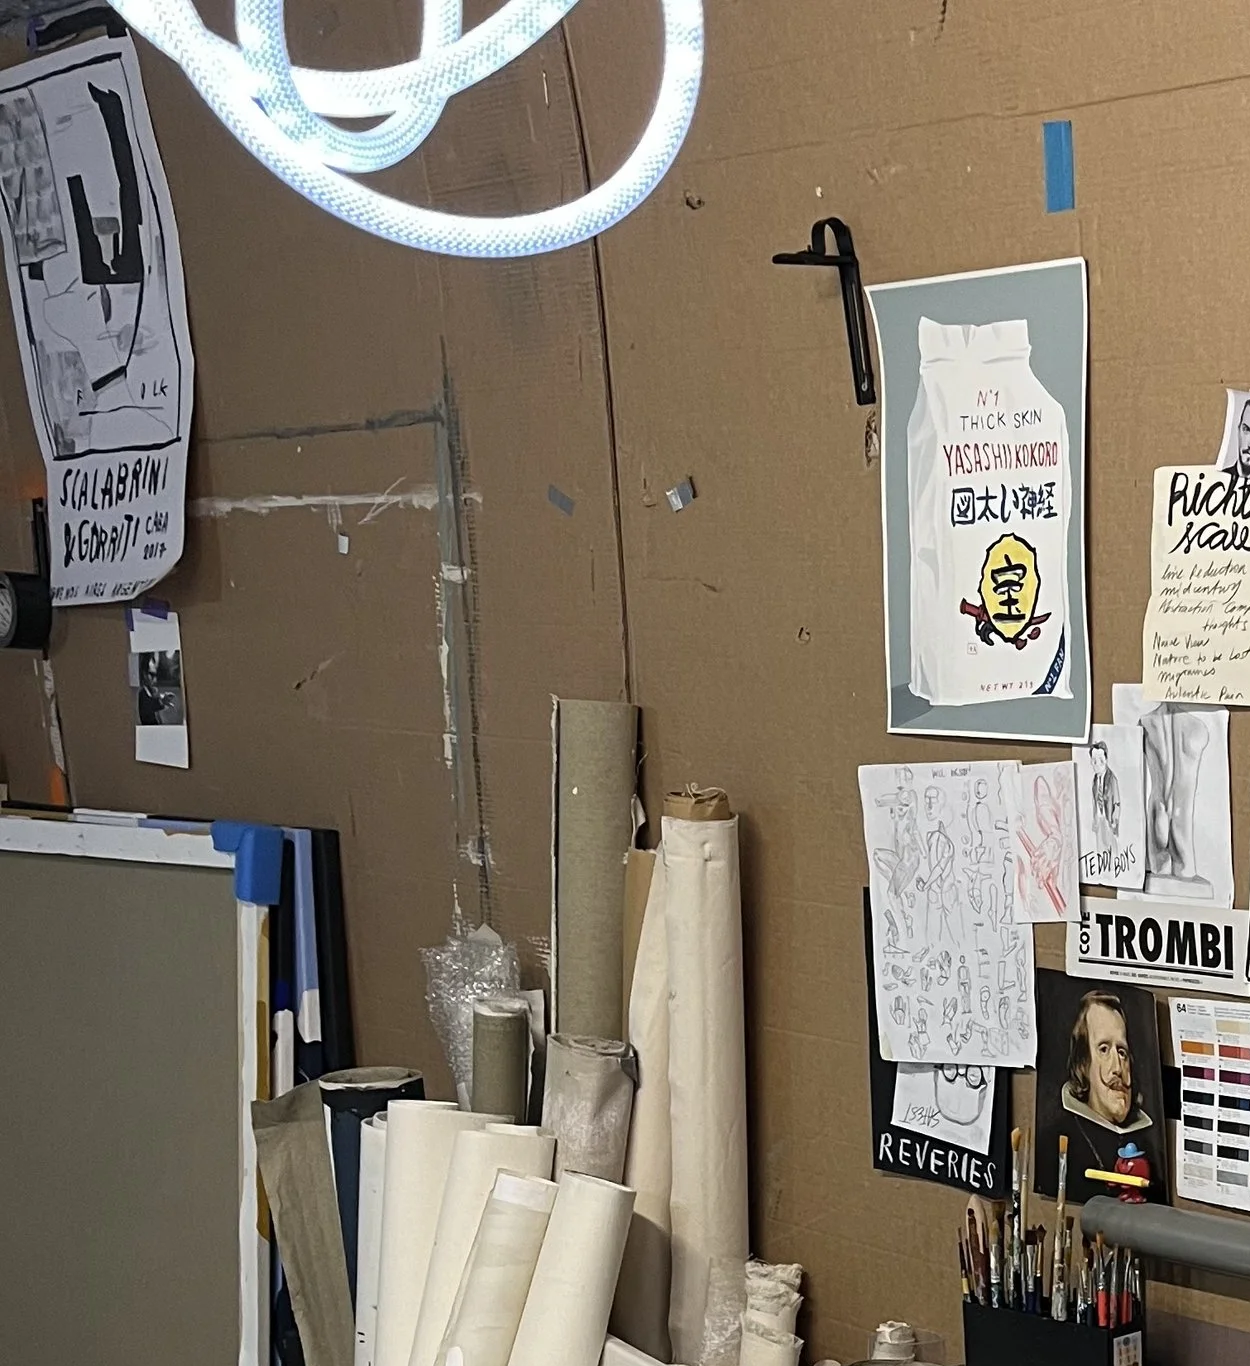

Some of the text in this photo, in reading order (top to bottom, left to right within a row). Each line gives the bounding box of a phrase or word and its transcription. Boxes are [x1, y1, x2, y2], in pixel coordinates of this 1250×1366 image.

[960, 408, 1042, 431] THICK SKIN
[60, 455, 169, 511] SCALABRINI
[144, 543, 167, 560] 2017
[1079, 843, 1136, 878] TEDDY BOYS
[1096, 913, 1233, 971] TROMBI
[879, 1132, 997, 1189] REVERIES
